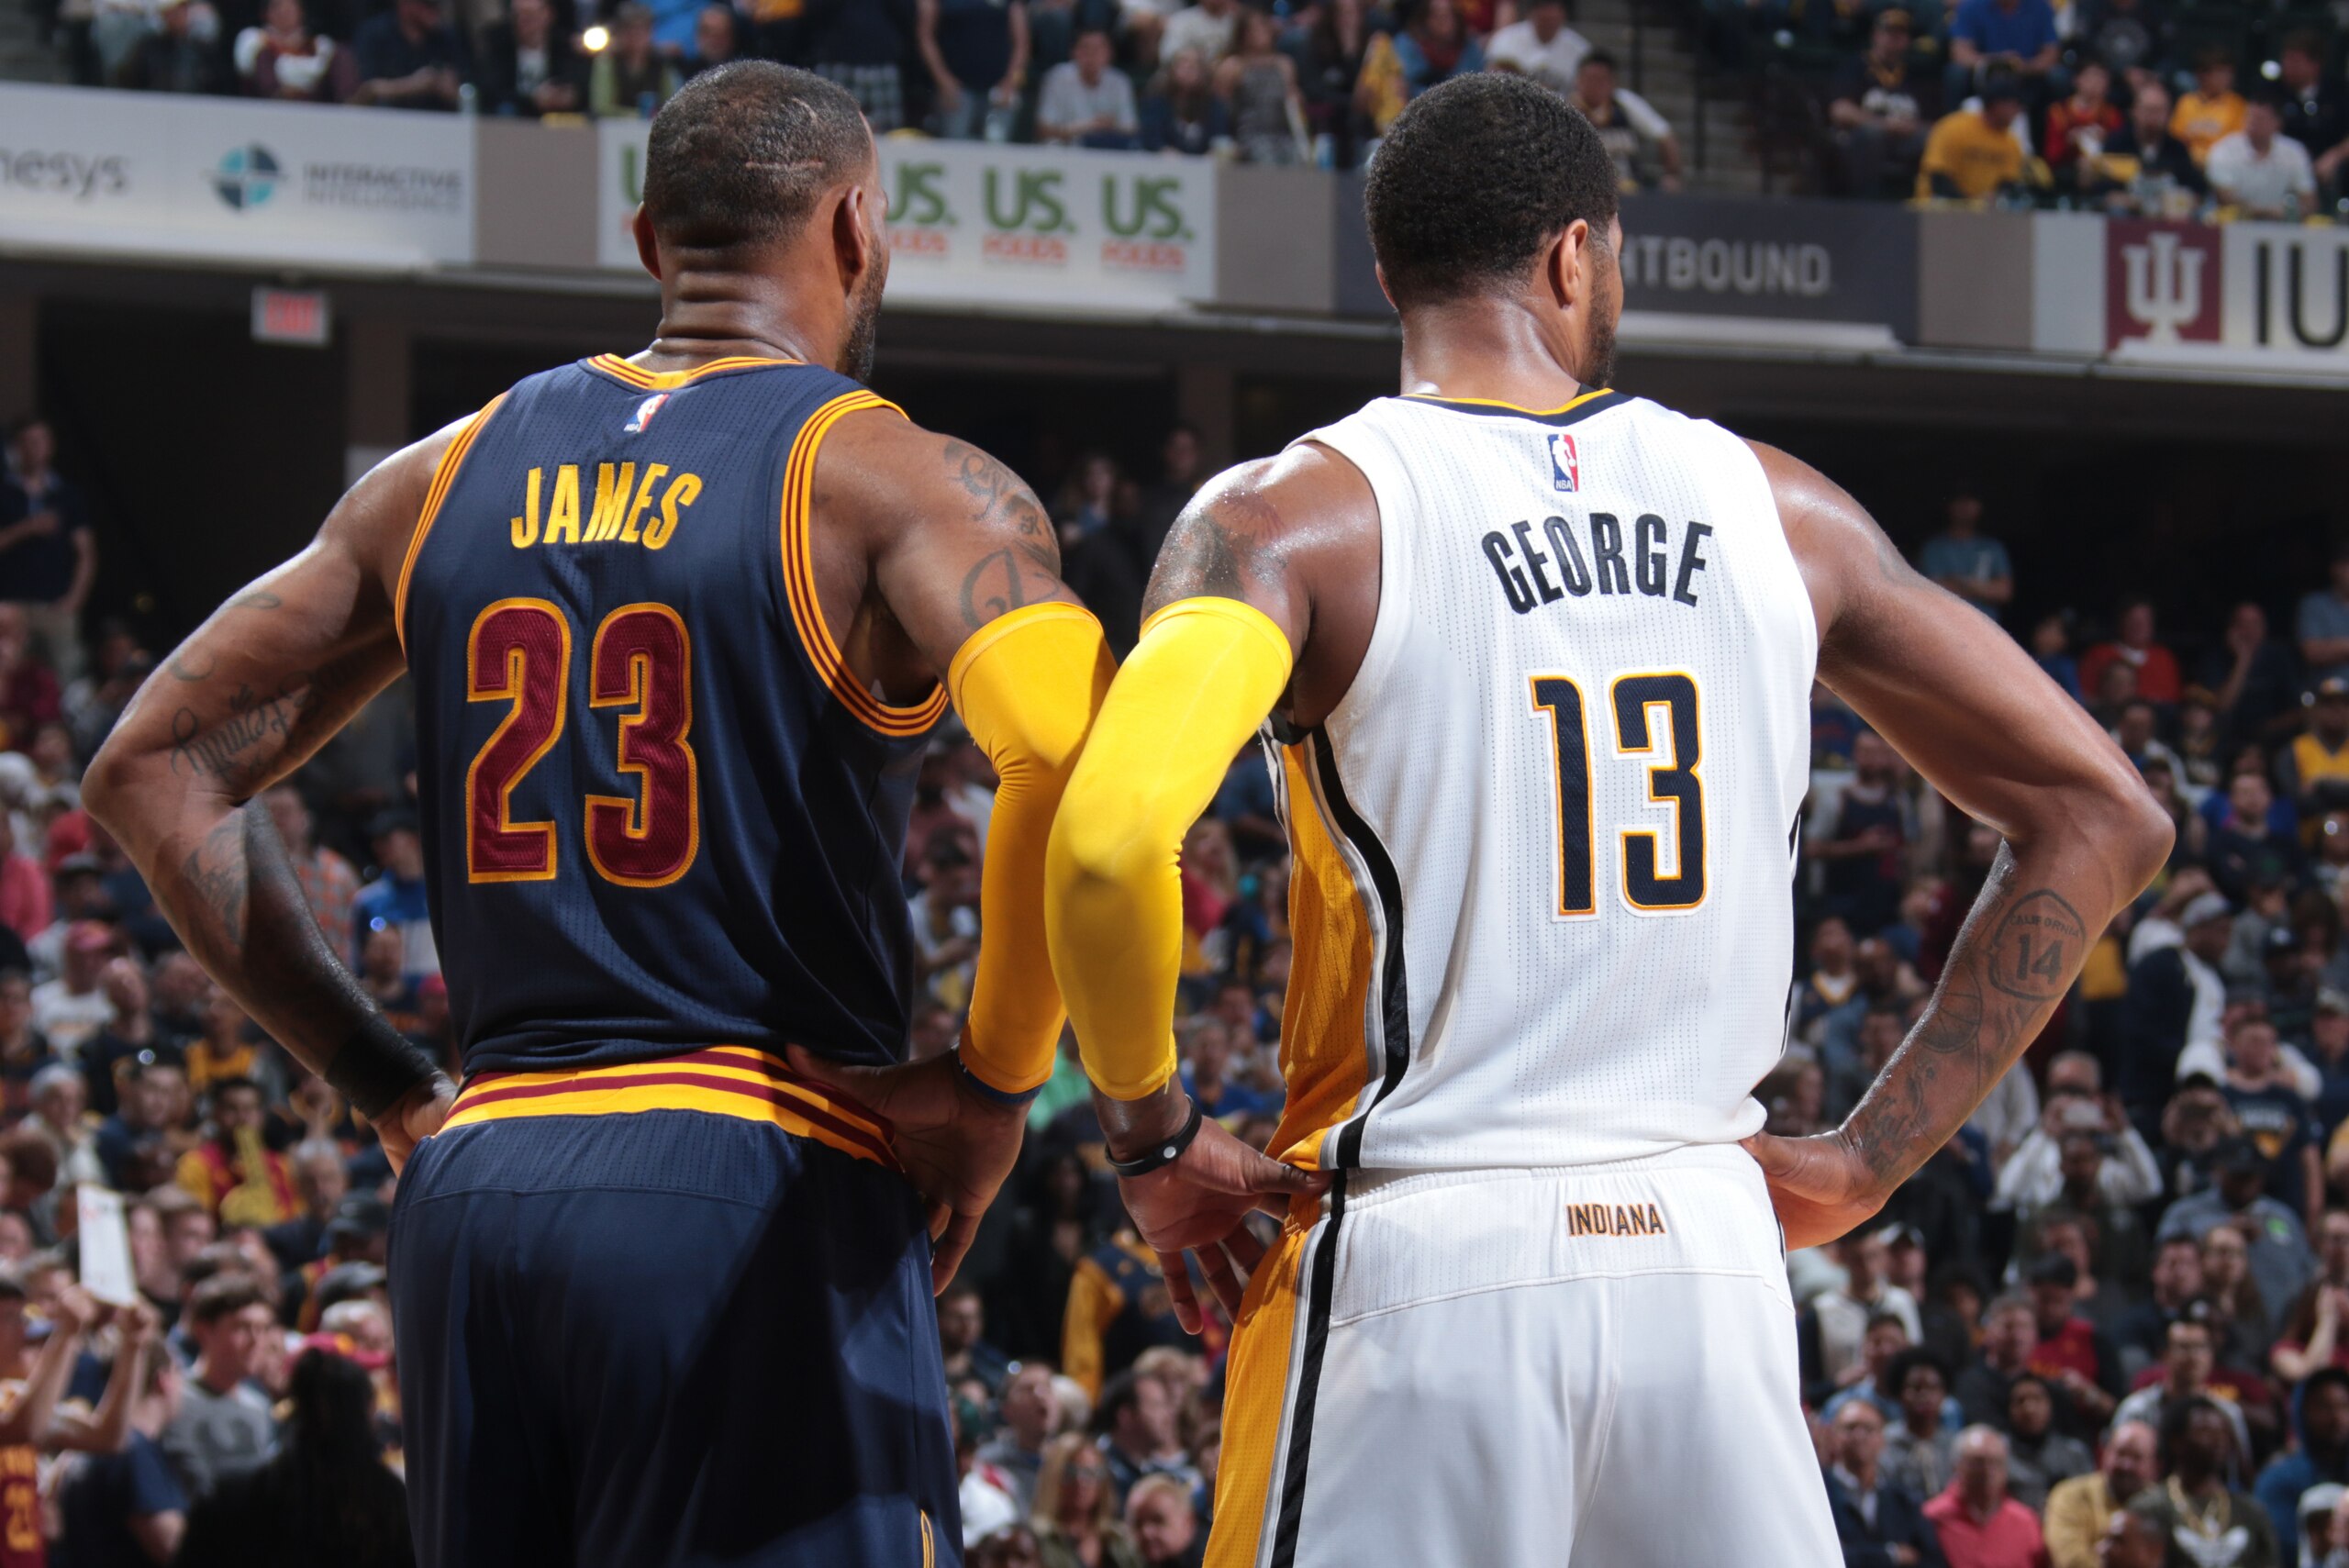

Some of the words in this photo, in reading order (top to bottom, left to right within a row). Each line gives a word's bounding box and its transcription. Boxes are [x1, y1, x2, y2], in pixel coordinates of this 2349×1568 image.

[510, 462, 703, 550] JAMES
[1556, 479, 1572, 490] NBA
[1481, 512, 1713, 615] GEORGE
[465, 597, 699, 888] 23
[1529, 671, 1708, 916] 13
[2017, 934, 2064, 985] 14
[1565, 1204, 1666, 1236] INDIANA
